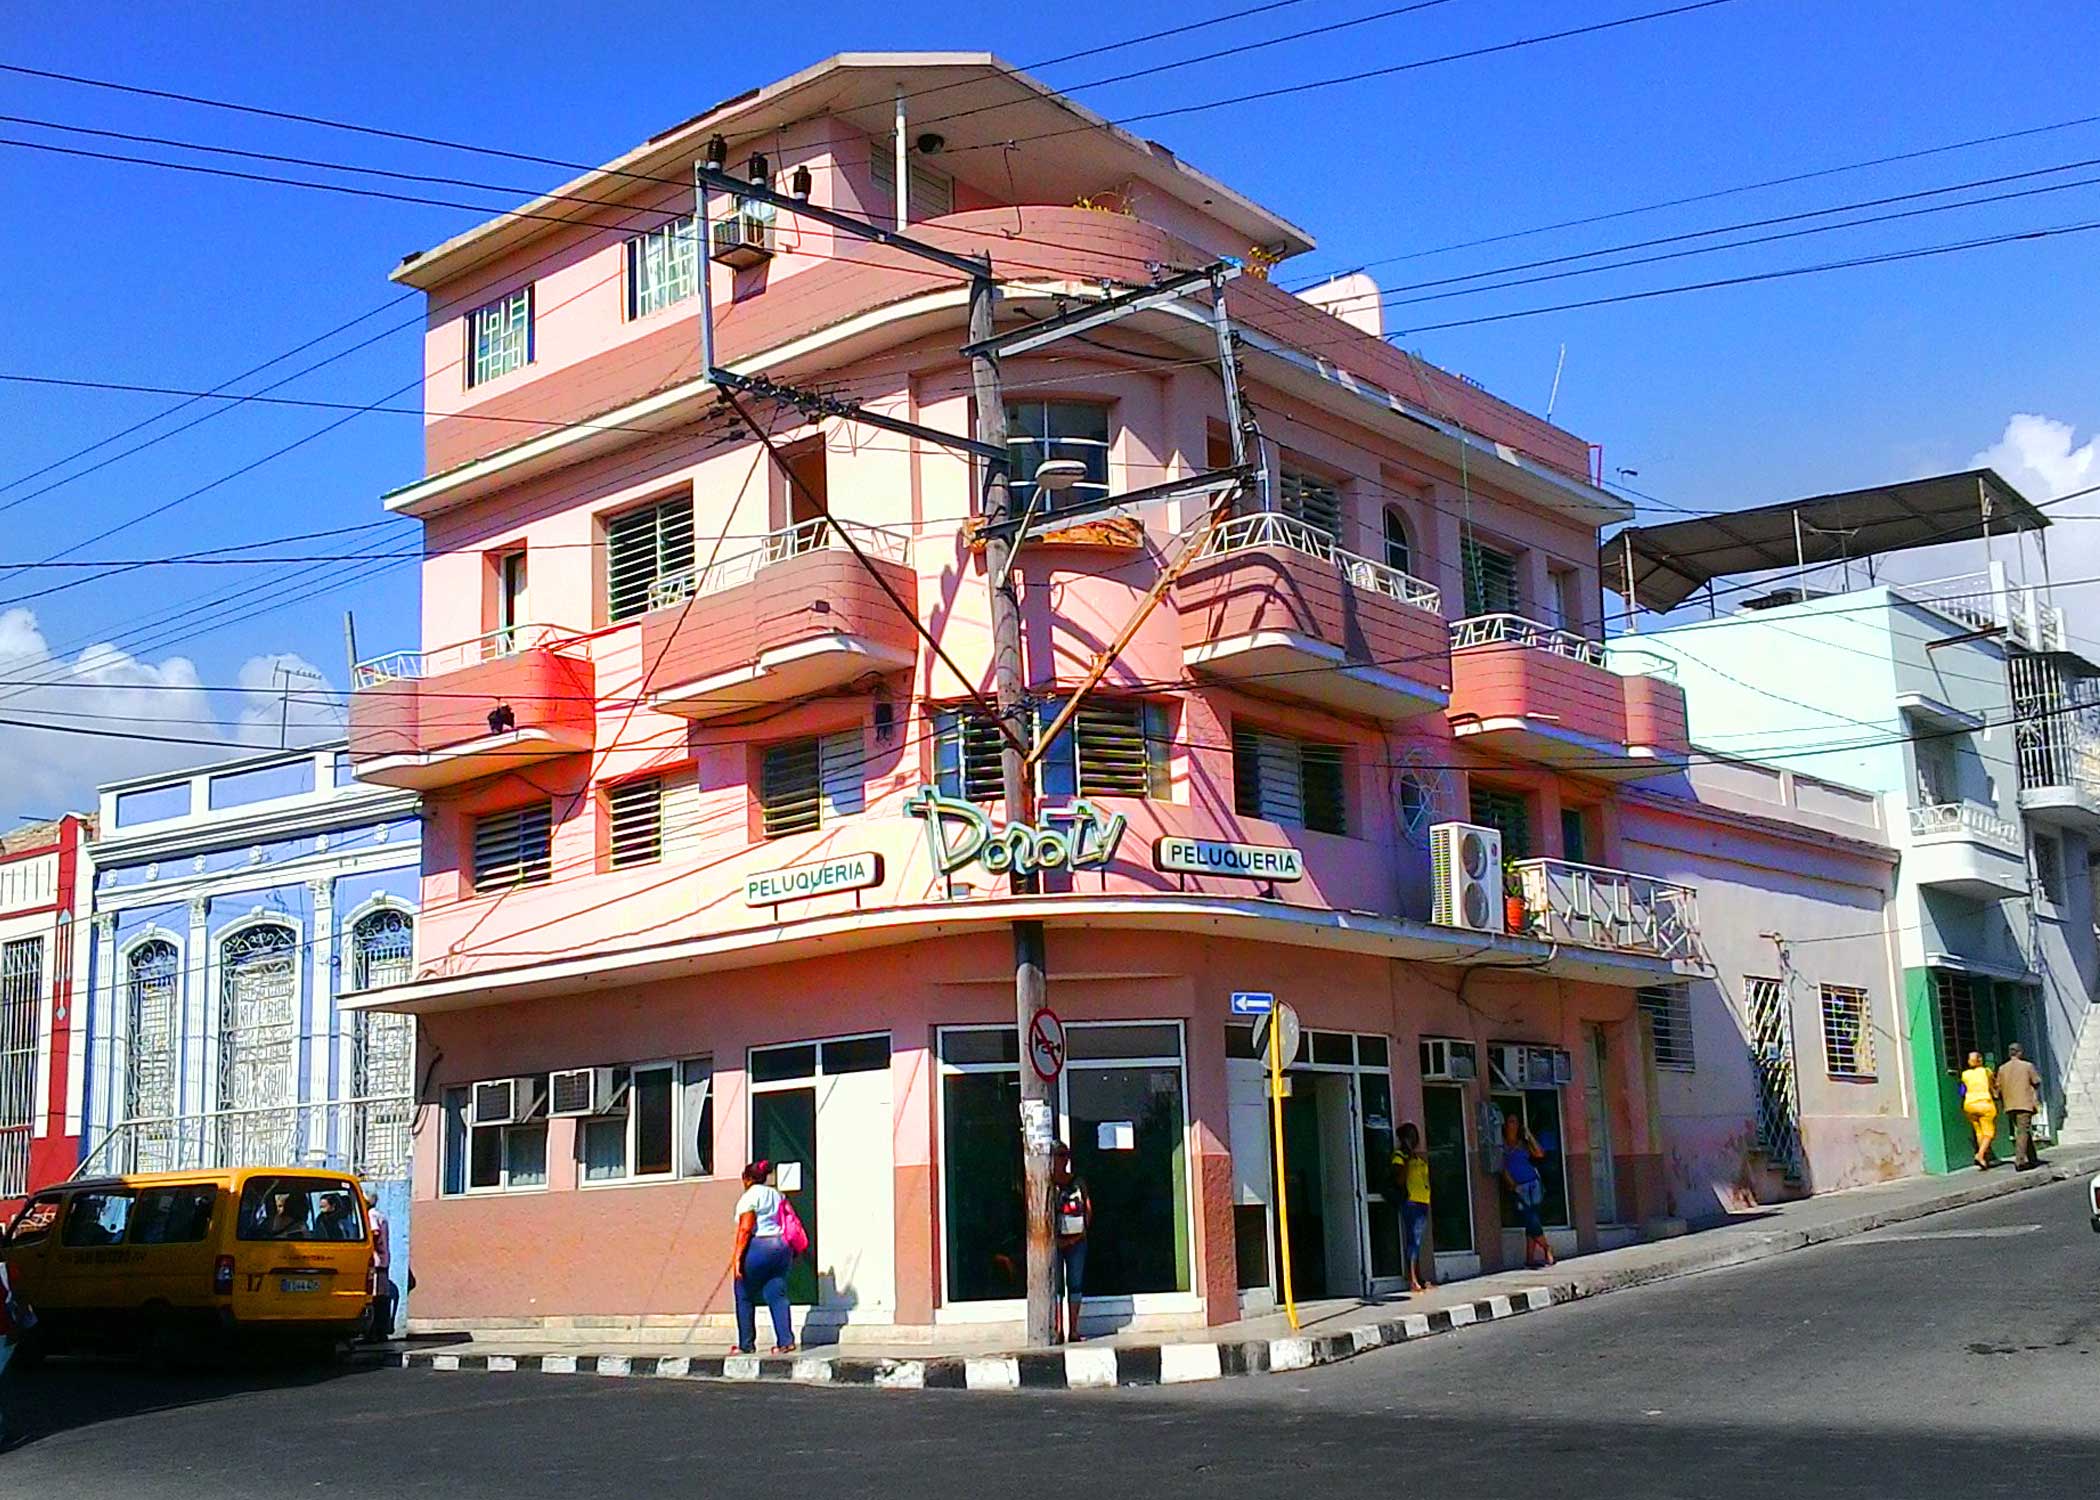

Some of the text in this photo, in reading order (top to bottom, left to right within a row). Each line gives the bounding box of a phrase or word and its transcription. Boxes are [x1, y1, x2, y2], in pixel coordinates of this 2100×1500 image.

[1170, 844, 1297, 874] PELUQUERIA
[748, 861, 865, 899] PELUQUERIA
[246, 1272, 264, 1293] 17
